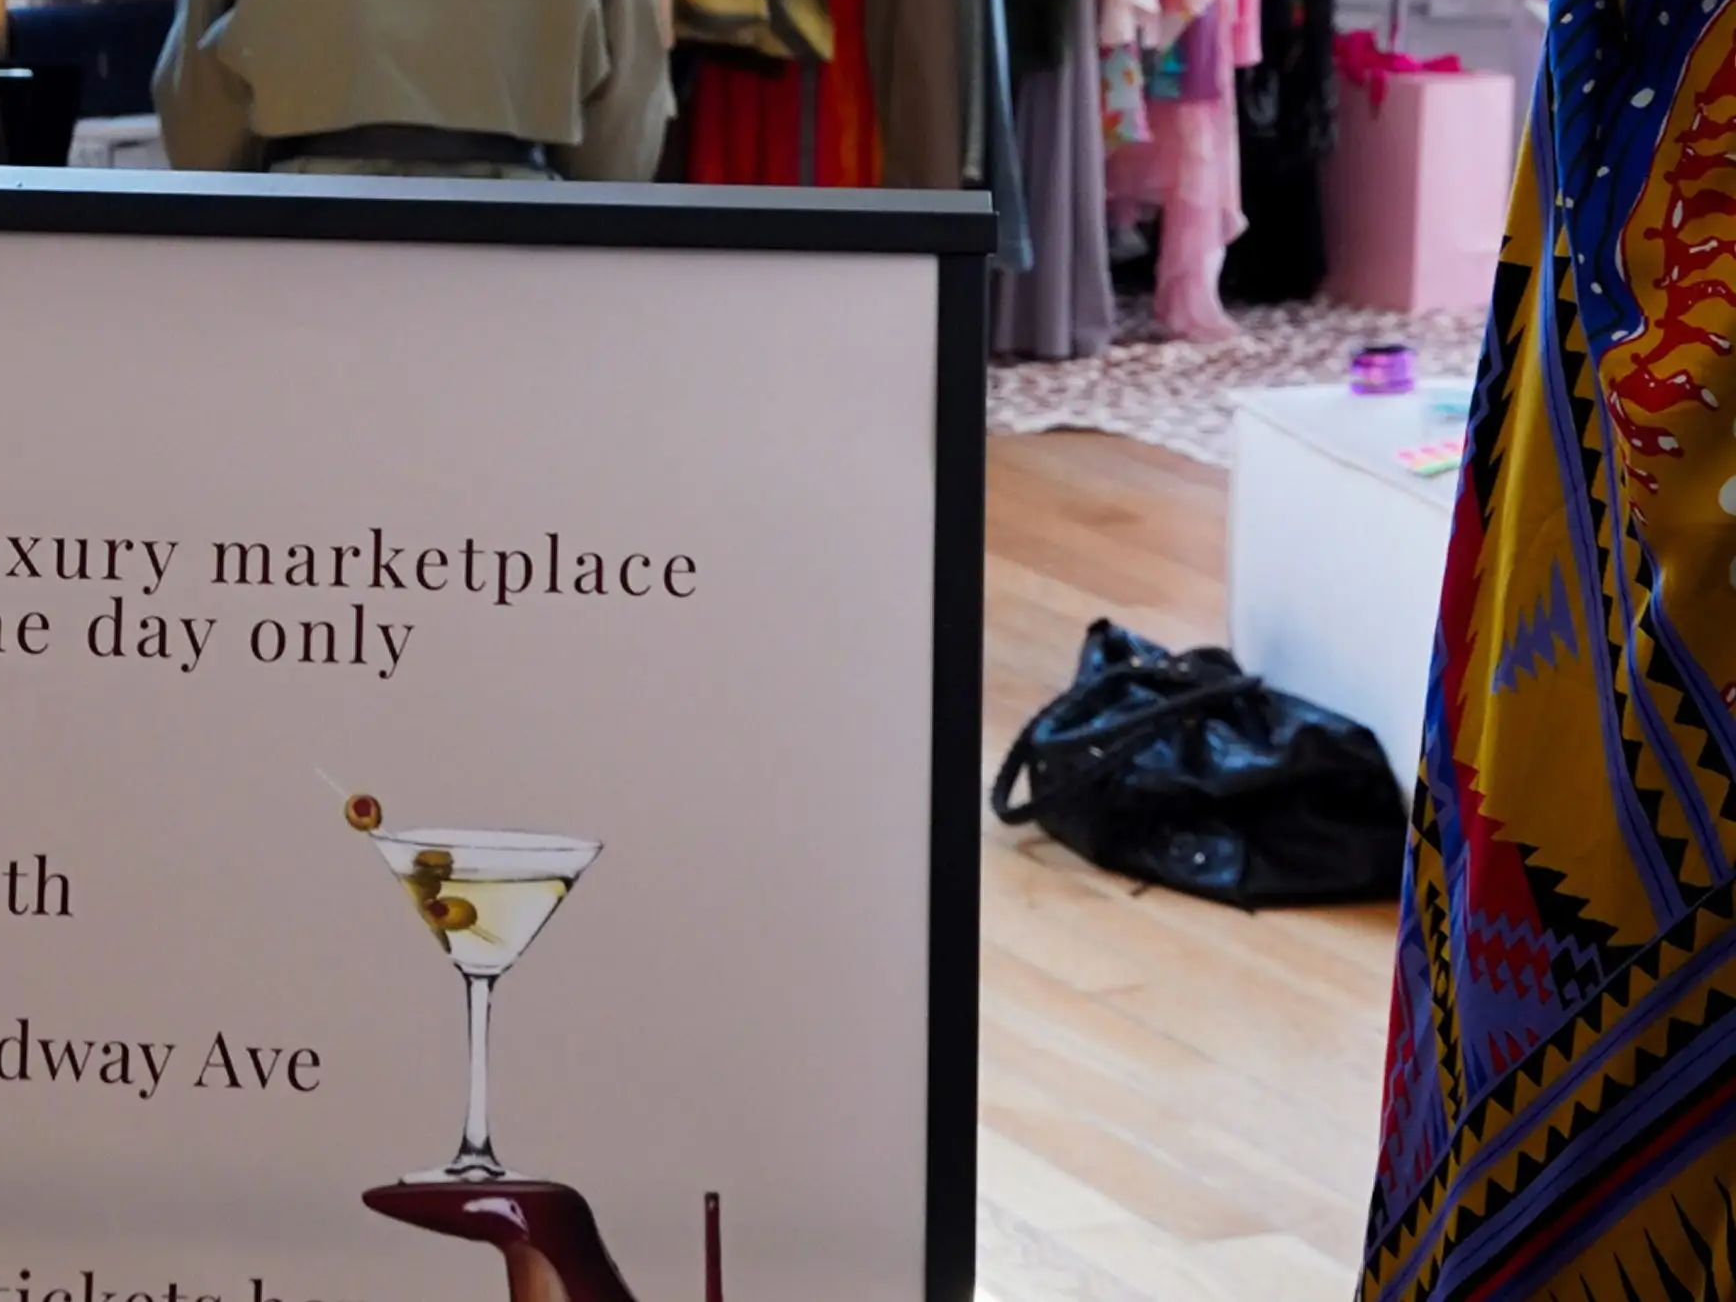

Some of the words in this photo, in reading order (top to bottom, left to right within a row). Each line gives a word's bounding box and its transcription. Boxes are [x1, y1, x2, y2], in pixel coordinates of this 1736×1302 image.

[210, 527, 698, 607] marketplace
[87, 594, 218, 675] day
[249, 602, 416, 680] only
[193, 1029, 322, 1093] Ave
